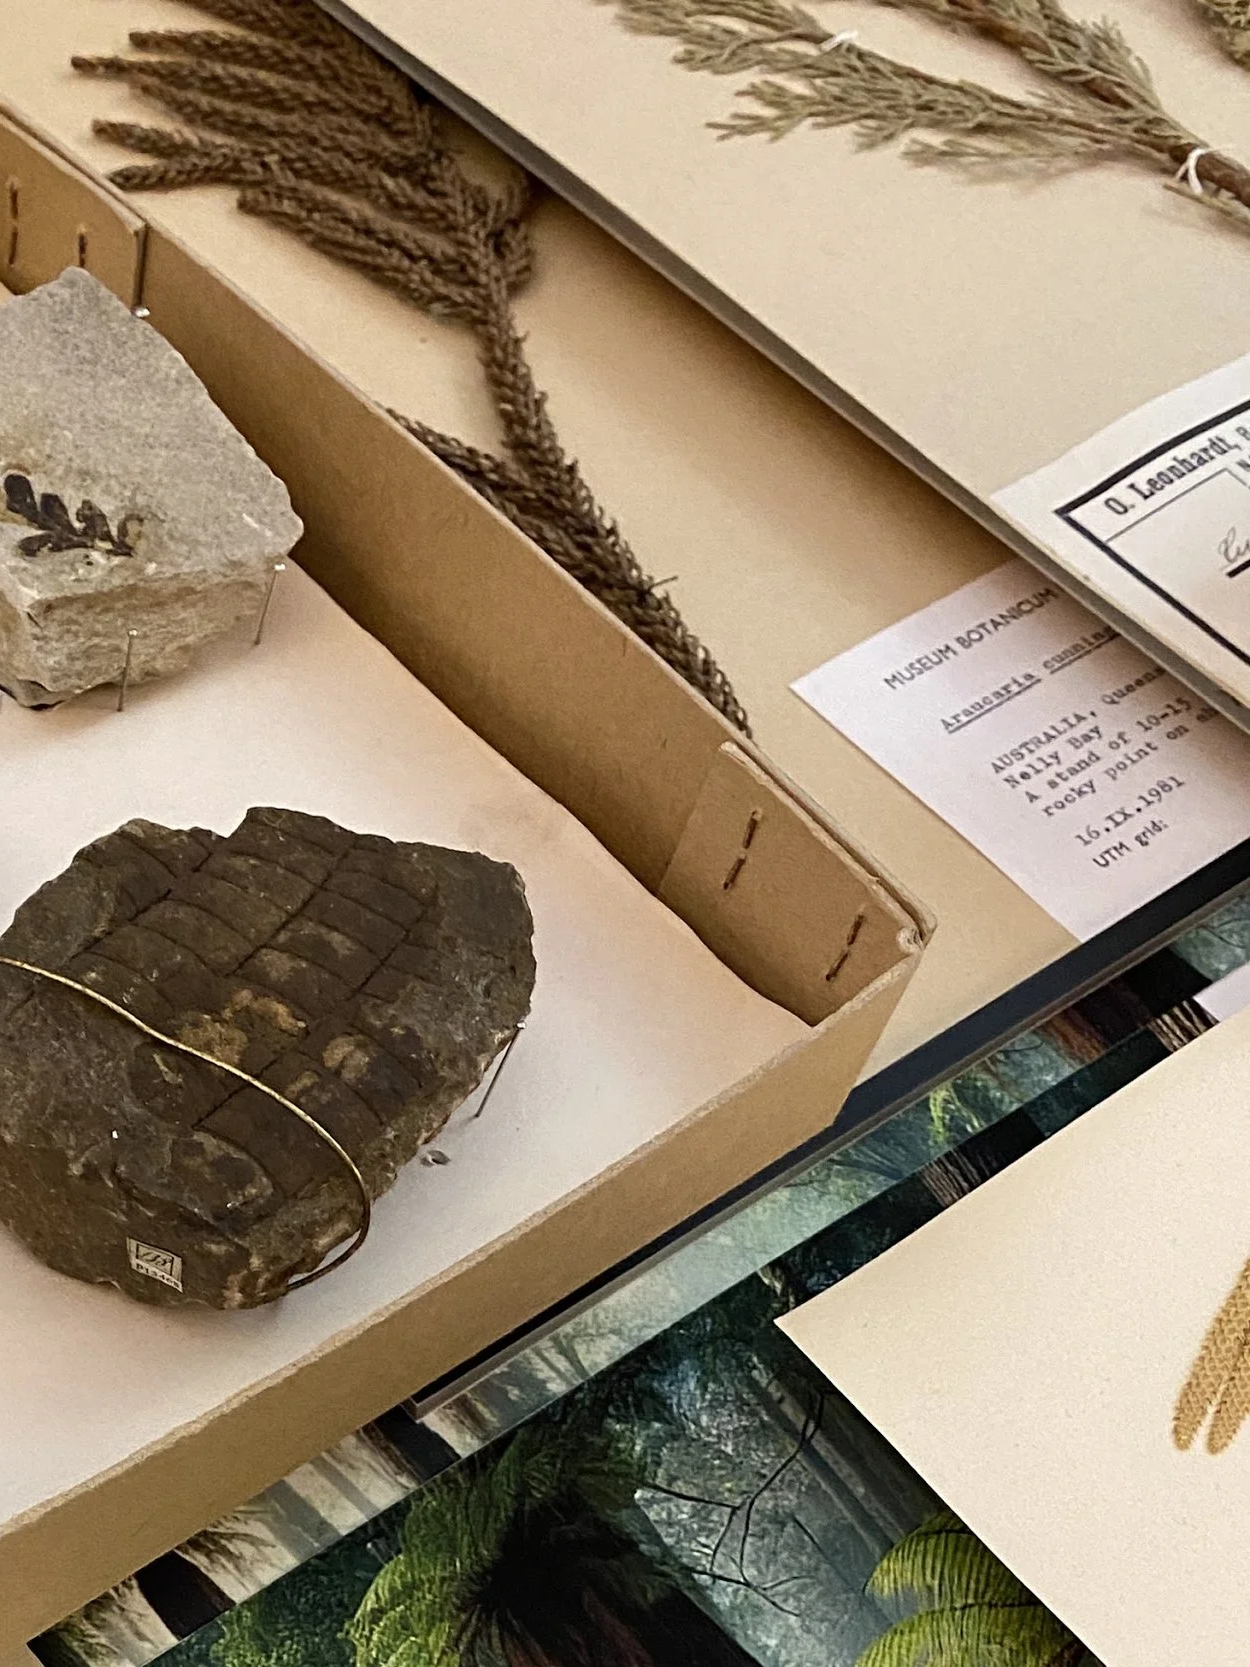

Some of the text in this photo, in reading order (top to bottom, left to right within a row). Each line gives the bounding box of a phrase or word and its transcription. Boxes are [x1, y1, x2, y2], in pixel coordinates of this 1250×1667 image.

[1128, 435, 1242, 500] Leonhardt,
[884, 588, 1059, 690] MUSEUM BOTANICUM
[940, 671, 1042, 733] Araucaria
[990, 711, 1097, 774] AUSTRALIA,
[1002, 724, 1104, 788] Nelly Bay
[1026, 697, 1192, 804] A stand of 10-15
[1043, 778, 1098, 818] rocky
[1105, 741, 1159, 780] point
[1165, 724, 1190, 740] on
[1076, 775, 1185, 847] 16.IX.1981
[1093, 820, 1169, 868] UTM grid:
